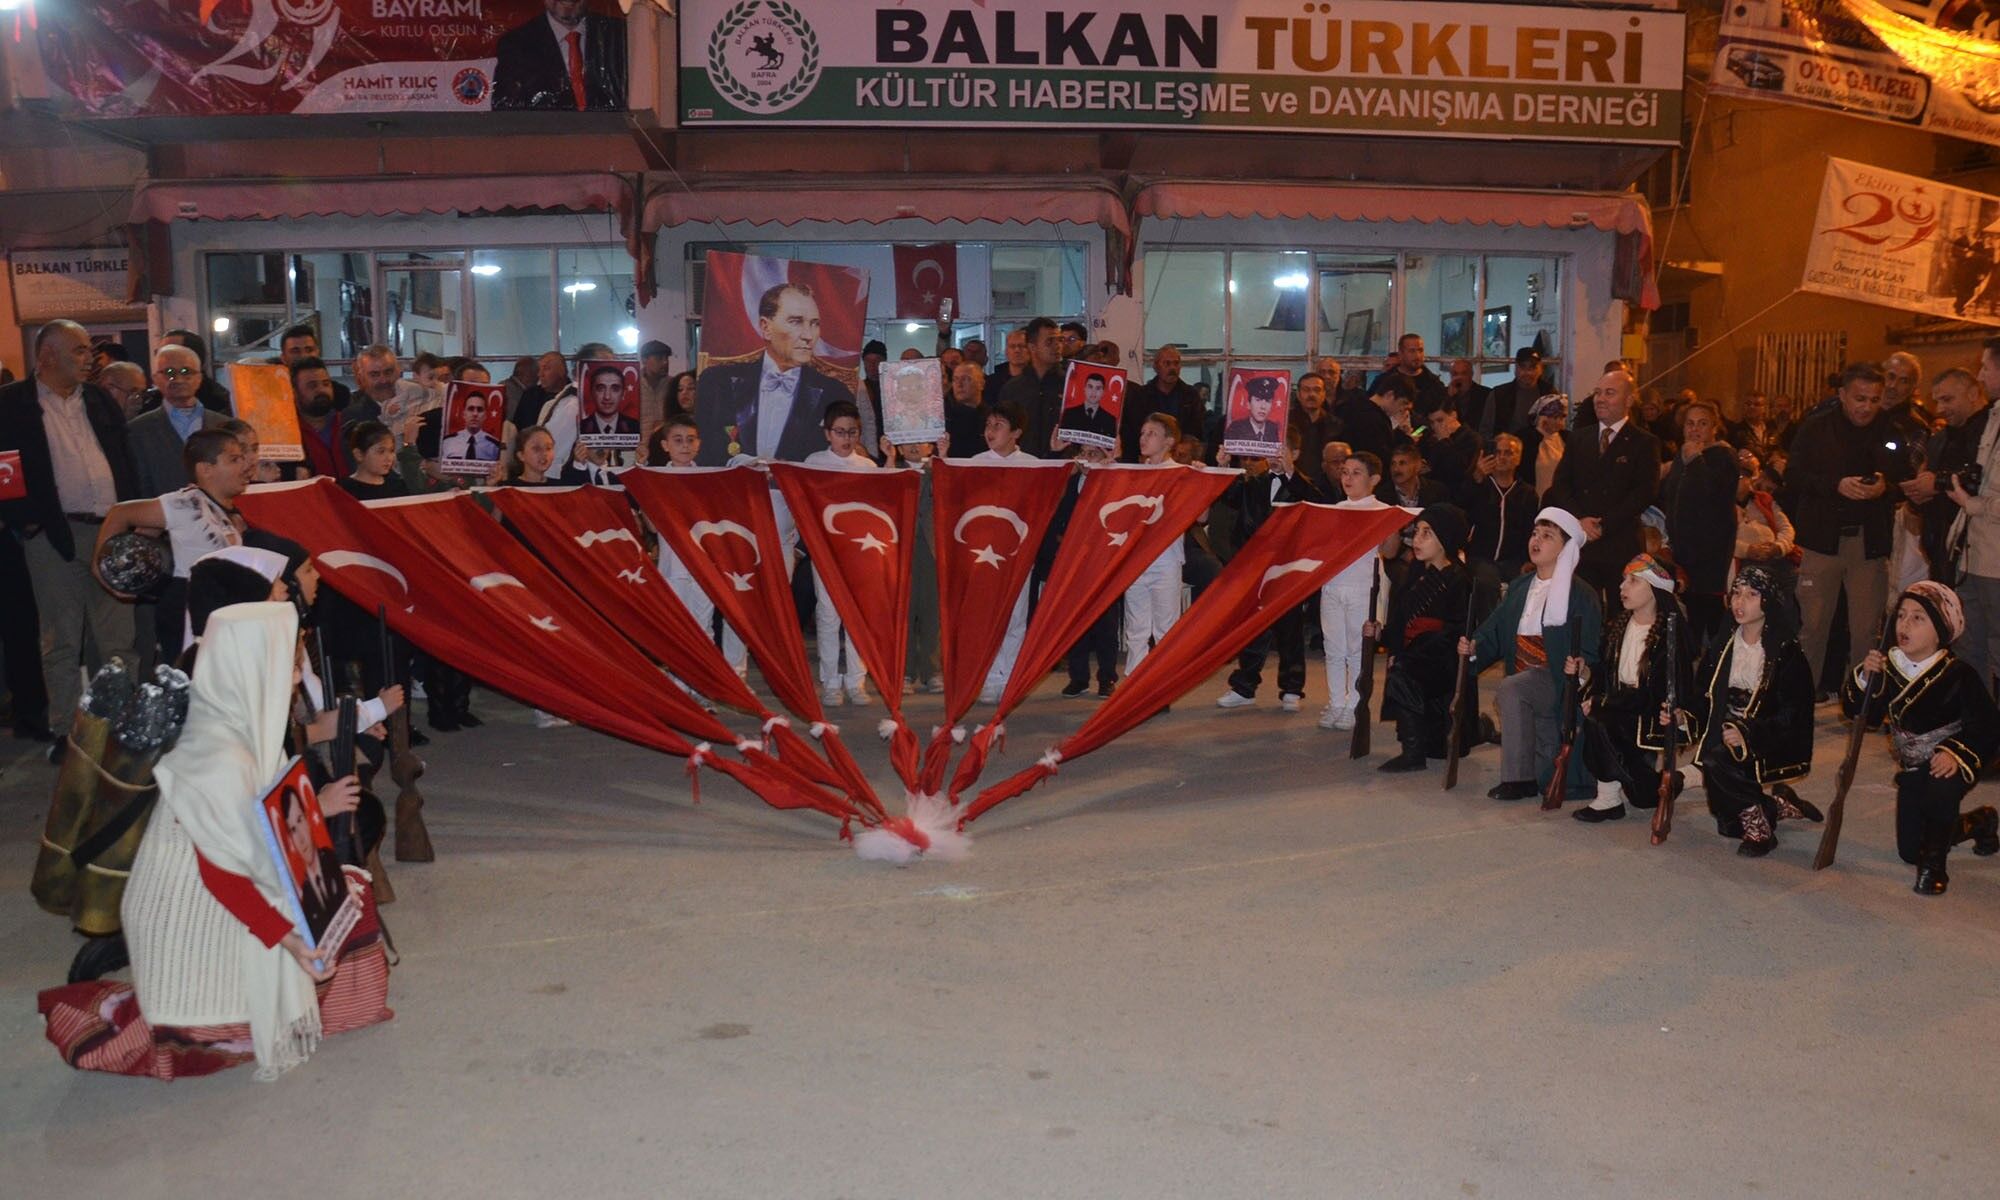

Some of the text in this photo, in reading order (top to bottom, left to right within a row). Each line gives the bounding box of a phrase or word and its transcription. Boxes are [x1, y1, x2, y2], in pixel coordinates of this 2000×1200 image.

[371, 0, 483, 18] BAYRAMI
[380, 24, 477, 38] KUTLU OLSUN
[735, 19, 760, 45] BALKAN
[876, 3, 1643, 84] BALKAN TÜRKLERİ
[344, 74, 393, 89] HAMİT
[399, 76, 438, 92] KILIÇ
[751, 71, 777, 79] BAFRA
[1800, 60, 1840, 84] OTO
[1846, 71, 1919, 100] GALERİ
[856, 72, 1659, 127] KÜLTÜR HABERLEŞME ve DAYANIŞMA DERNEĞİ
[16, 262, 71, 276] BALKAN
